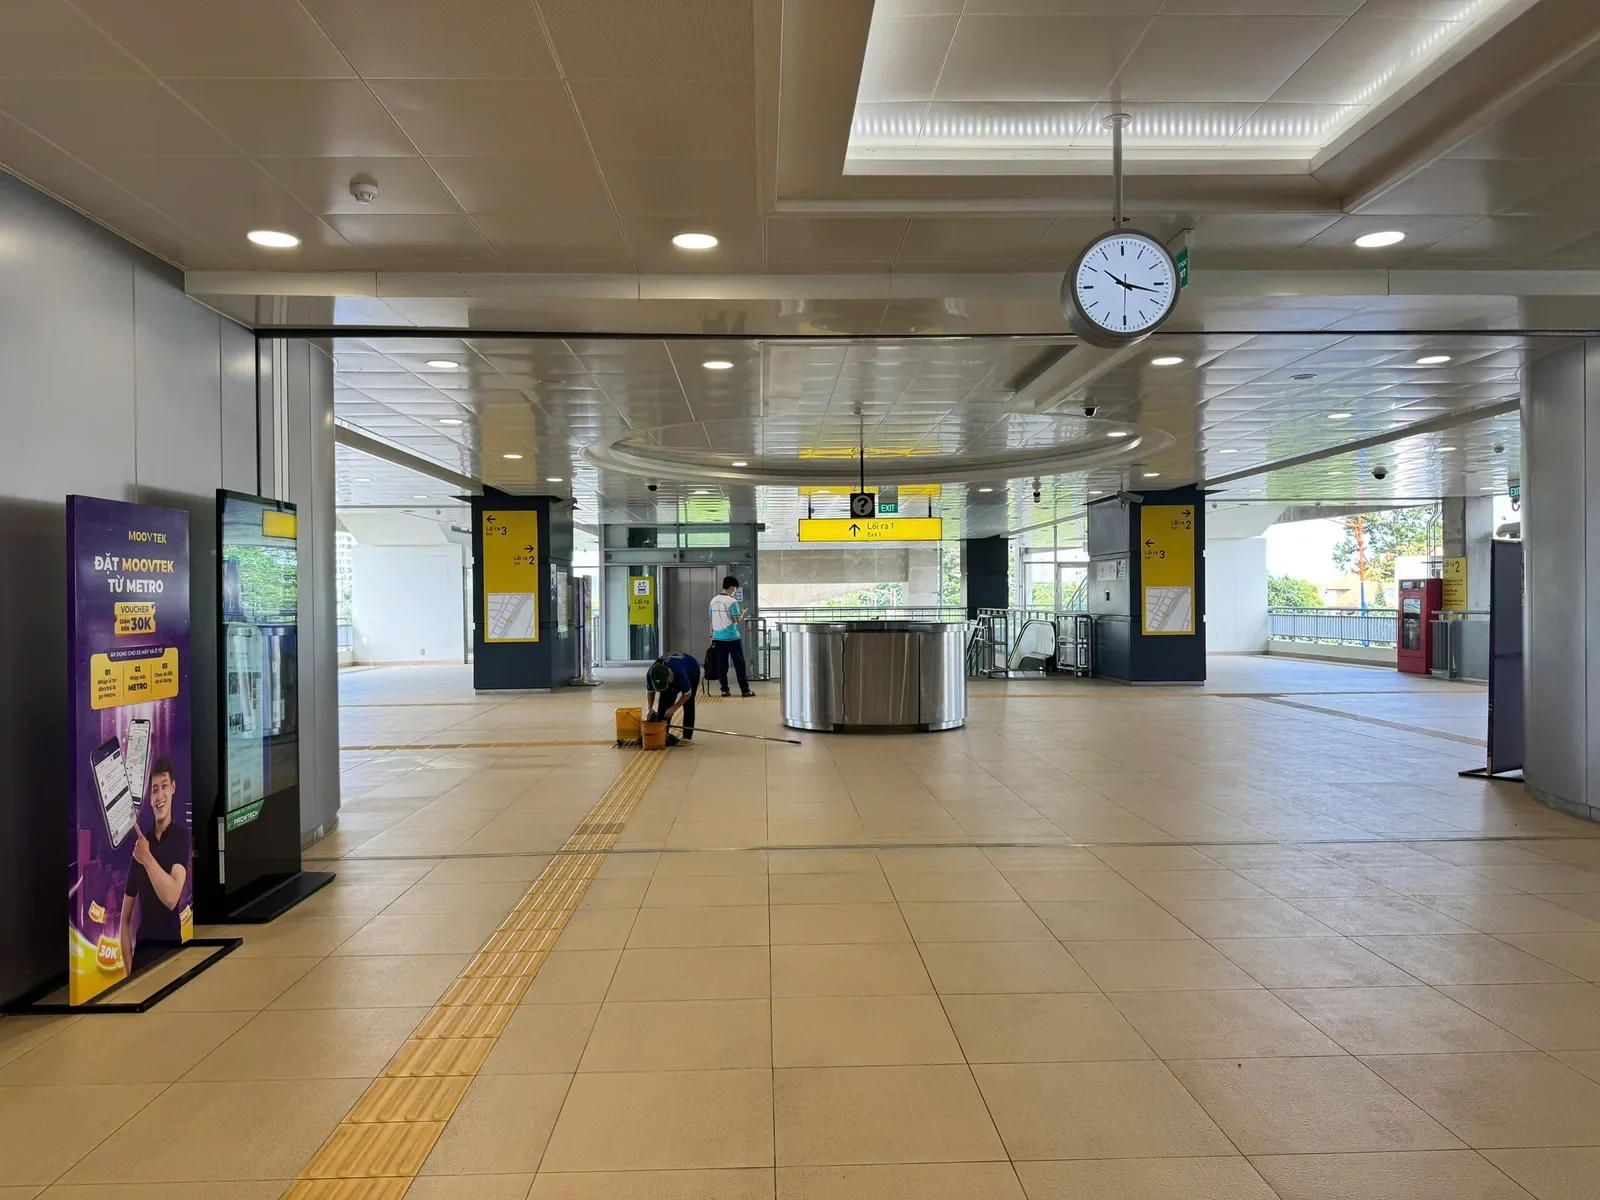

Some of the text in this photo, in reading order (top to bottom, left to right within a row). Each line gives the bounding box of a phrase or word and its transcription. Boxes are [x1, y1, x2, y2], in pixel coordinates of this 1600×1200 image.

[867, 521, 878, 530] Lối
[1186, 520, 1191, 529] 2
[501, 526, 507, 535] 3
[128, 530, 167, 543] MOOVTEK
[1160, 550, 1165, 559] 3
[94, 552, 174, 574] ĐẶT MOOVTEK
[529, 556, 535, 564] 2
[1455, 561, 1460, 572] 2
[108, 575, 163, 593] TỪ METRO
[131, 617, 152, 630] 30K
[128, 682, 147, 691] METRO
[99, 945, 118, 960] 30K
